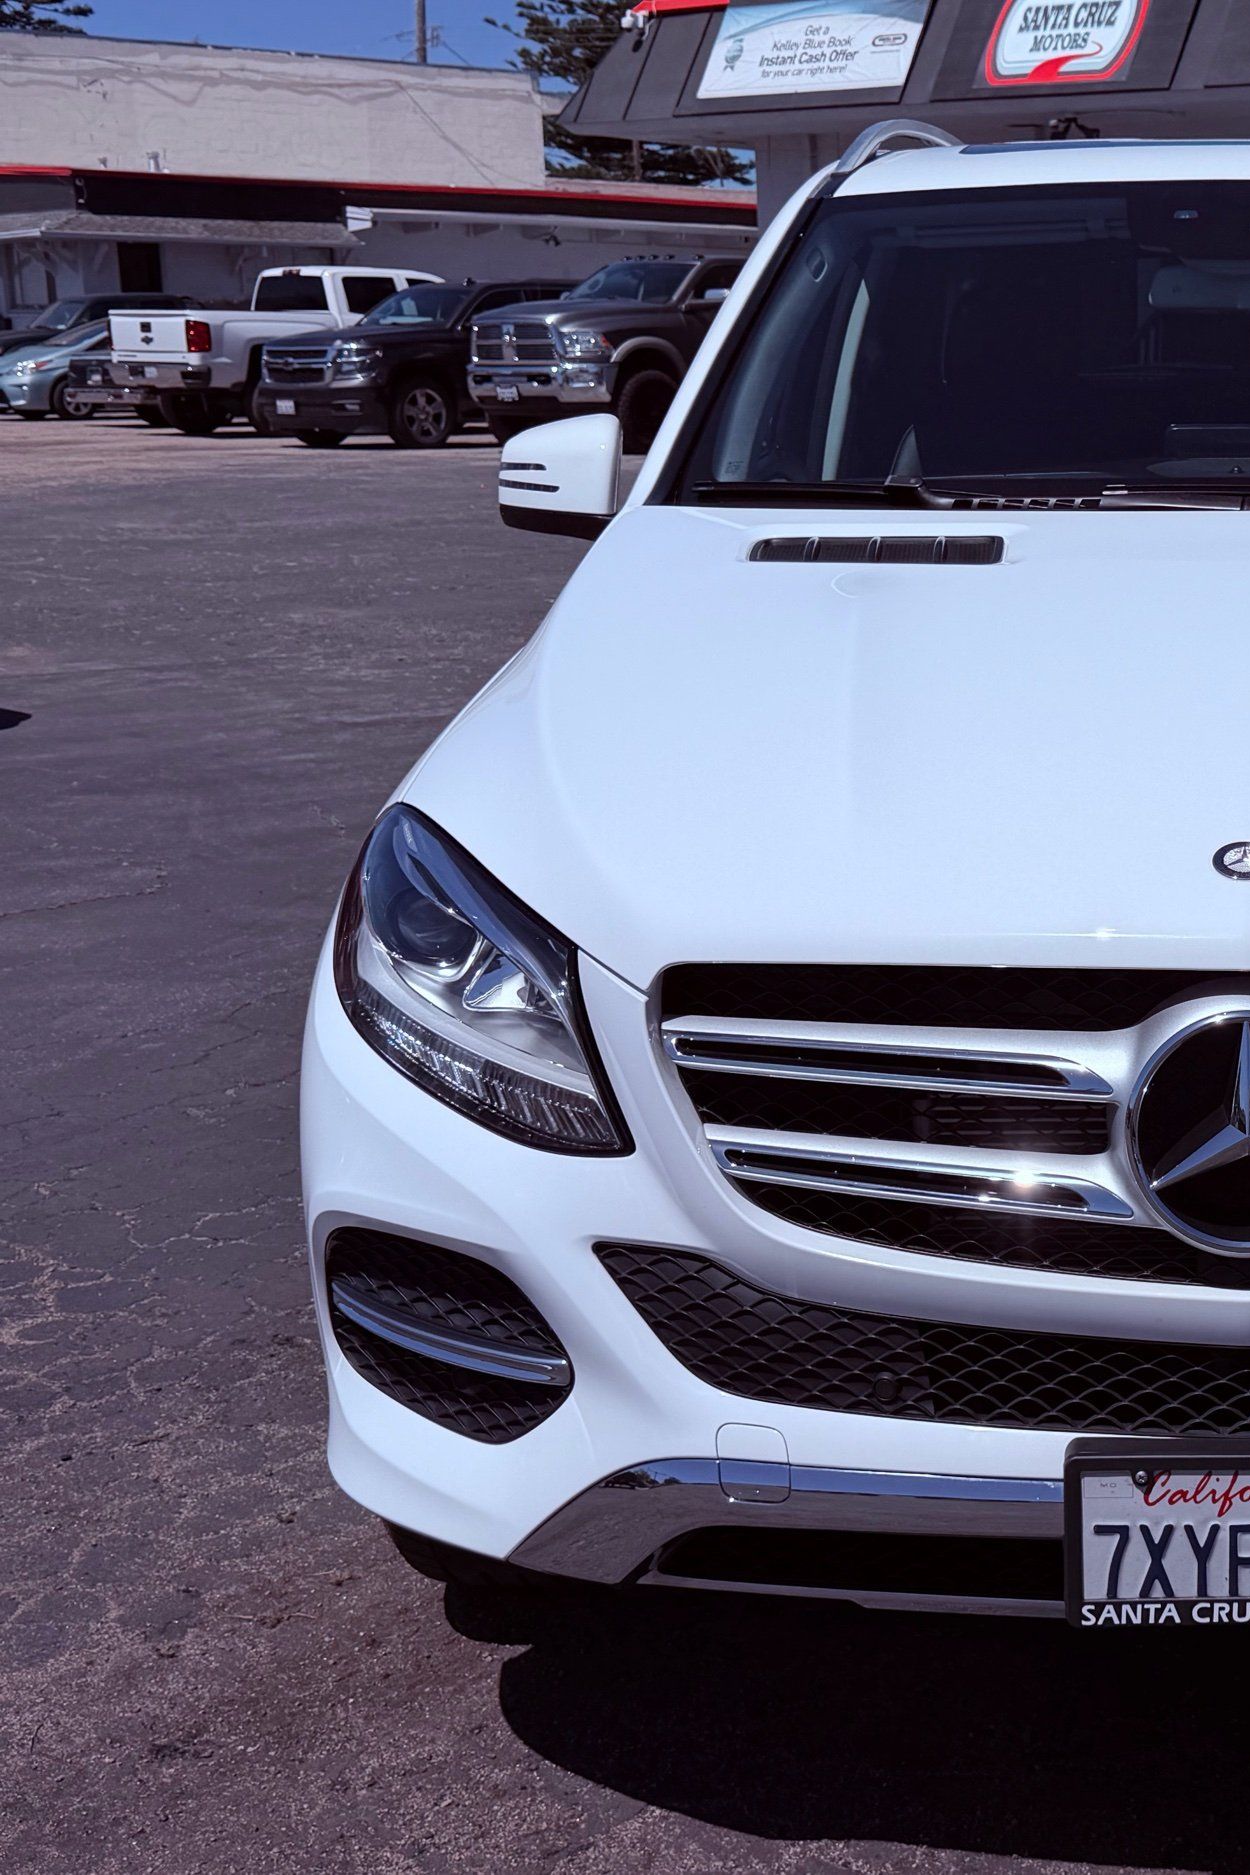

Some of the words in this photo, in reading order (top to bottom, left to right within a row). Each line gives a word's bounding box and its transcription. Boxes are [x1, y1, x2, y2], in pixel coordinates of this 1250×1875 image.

[1018, 4, 1073, 33] SANTA
[1074, 1, 1121, 29] CRUZ
[805, 25, 822, 36] Get
[772, 40, 801, 51] Kelley
[803, 38, 825, 50] Blue
[827, 36, 853, 48] Book
[1029, 32, 1090, 52] MOTORS
[759, 53, 797, 67] Instant
[799, 51, 827, 64] Cash
[829, 49, 859, 62] Offer
[761, 69, 772, 78] for
[773, 69, 790, 79] your
[791, 68, 805, 76] car
[805, 65, 825, 78] right
[1081, 1602, 1181, 1625] SANTA
